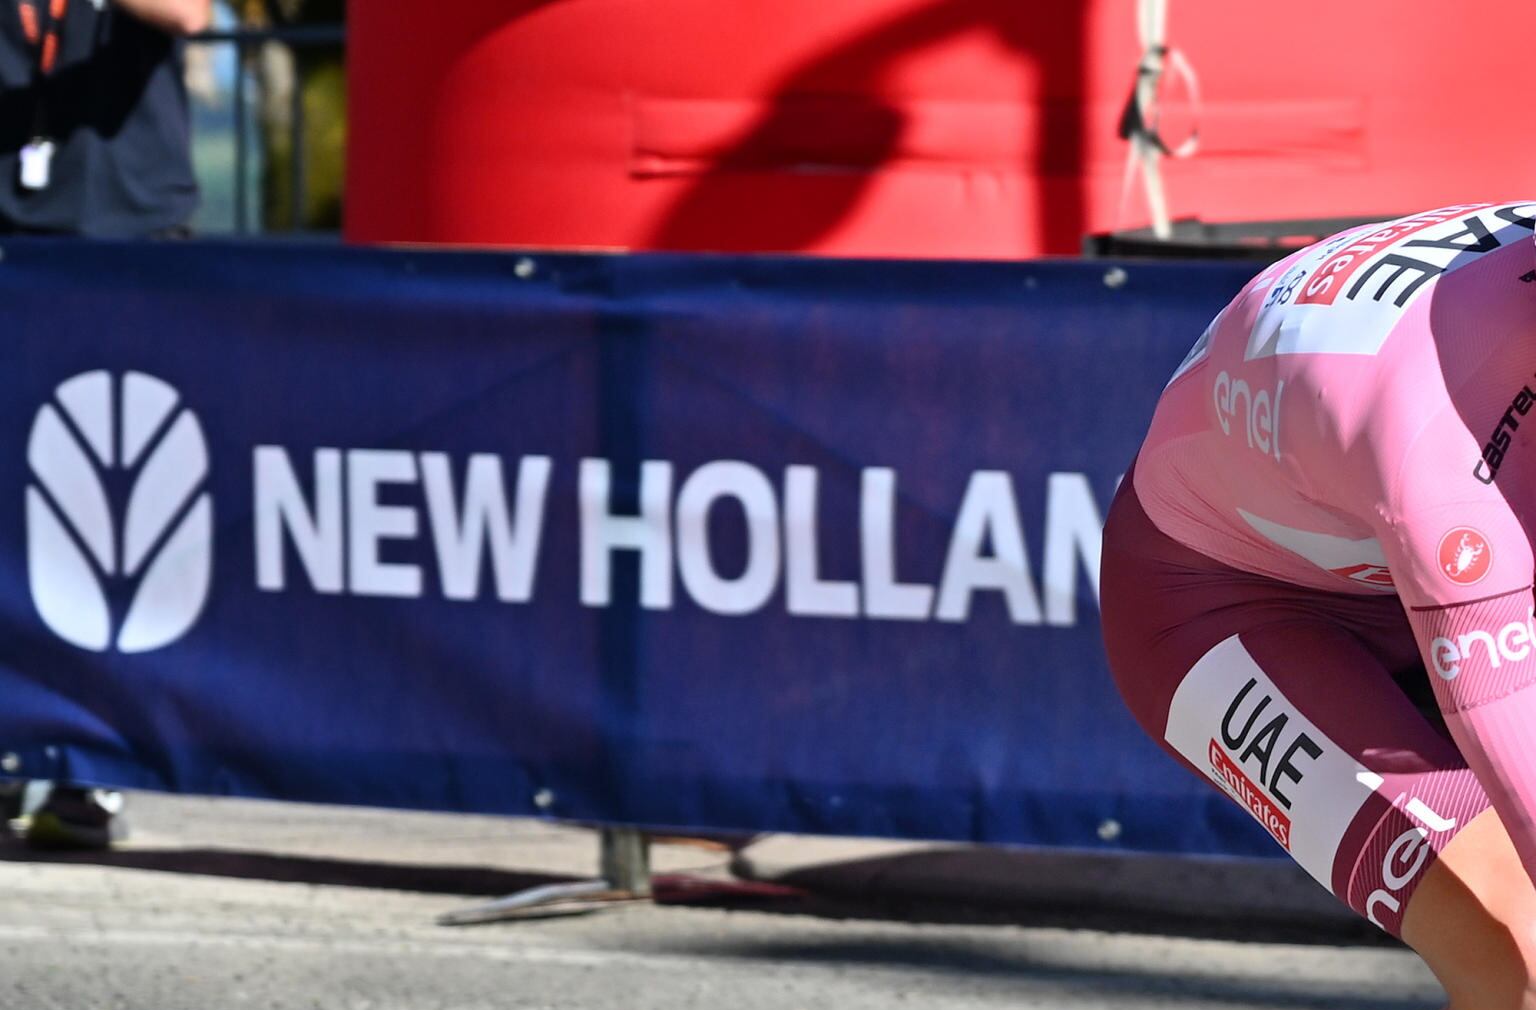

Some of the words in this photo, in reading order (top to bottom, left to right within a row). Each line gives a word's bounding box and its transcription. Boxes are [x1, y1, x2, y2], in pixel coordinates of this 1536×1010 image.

[1213, 371, 1285, 463] enel
[253, 446, 553, 602] NEW
[577, 459, 1123, 626] HOLLAN
[1211, 744, 1288, 846] Emirates
[1220, 677, 1324, 811] UAE
